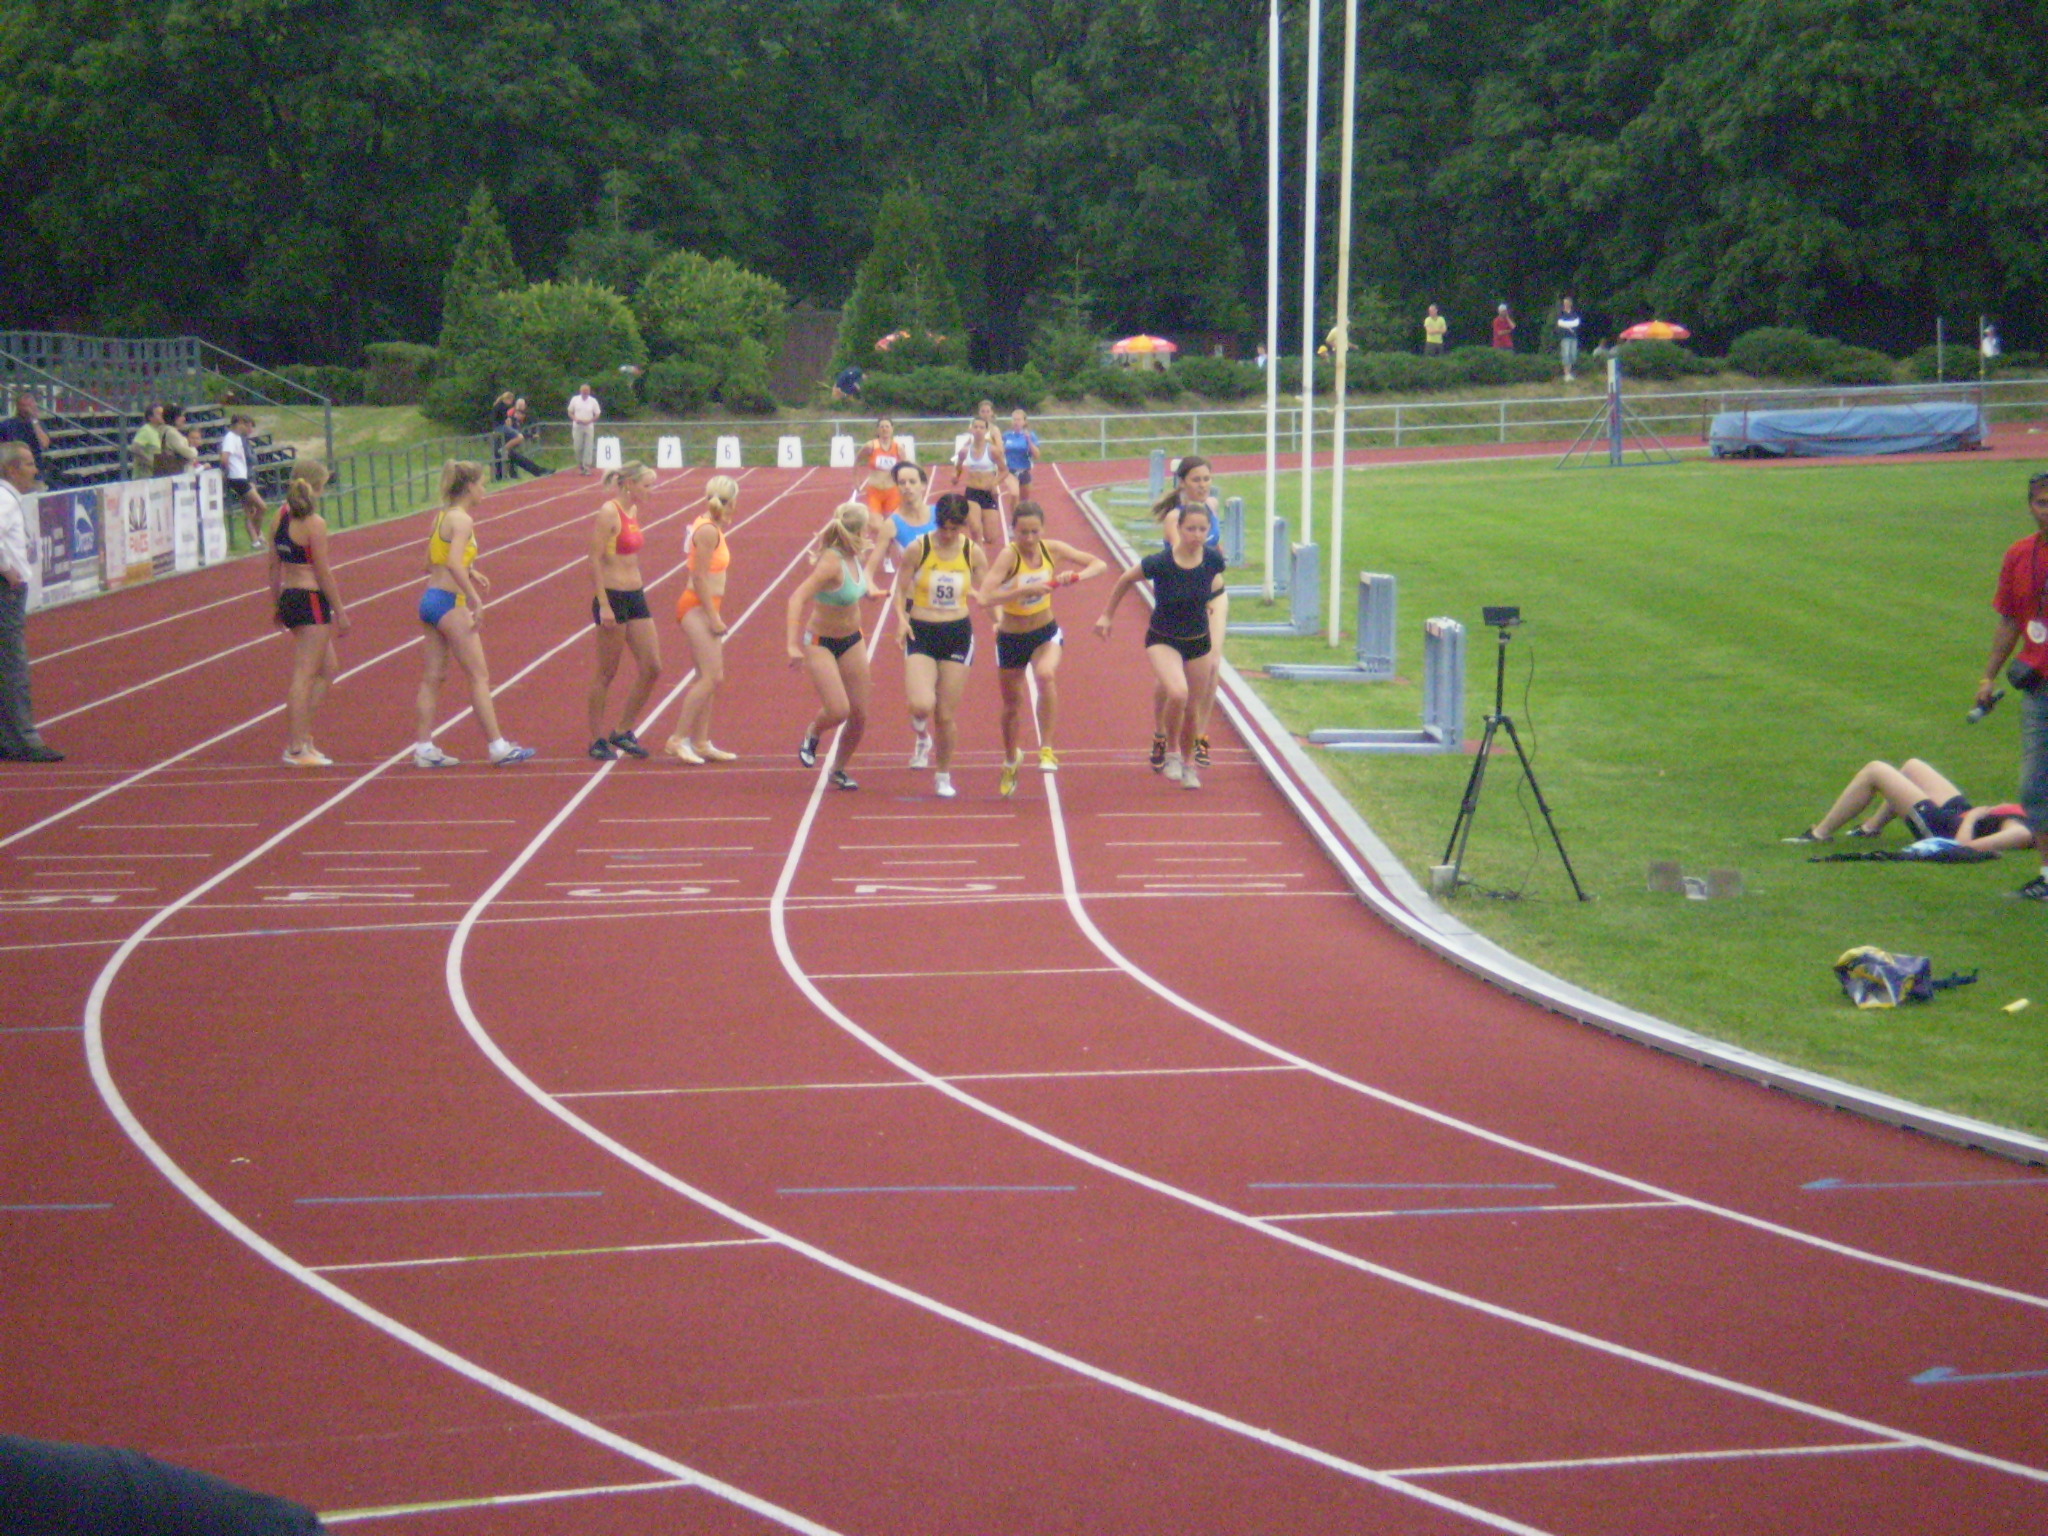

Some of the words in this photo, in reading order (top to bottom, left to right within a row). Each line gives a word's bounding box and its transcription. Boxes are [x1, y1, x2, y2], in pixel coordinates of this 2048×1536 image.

[605, 446, 612, 460] 8
[666, 445, 673, 460] 7
[724, 445, 731, 460] 6
[786, 445, 793, 460] 5
[936, 585, 954, 599] 53
